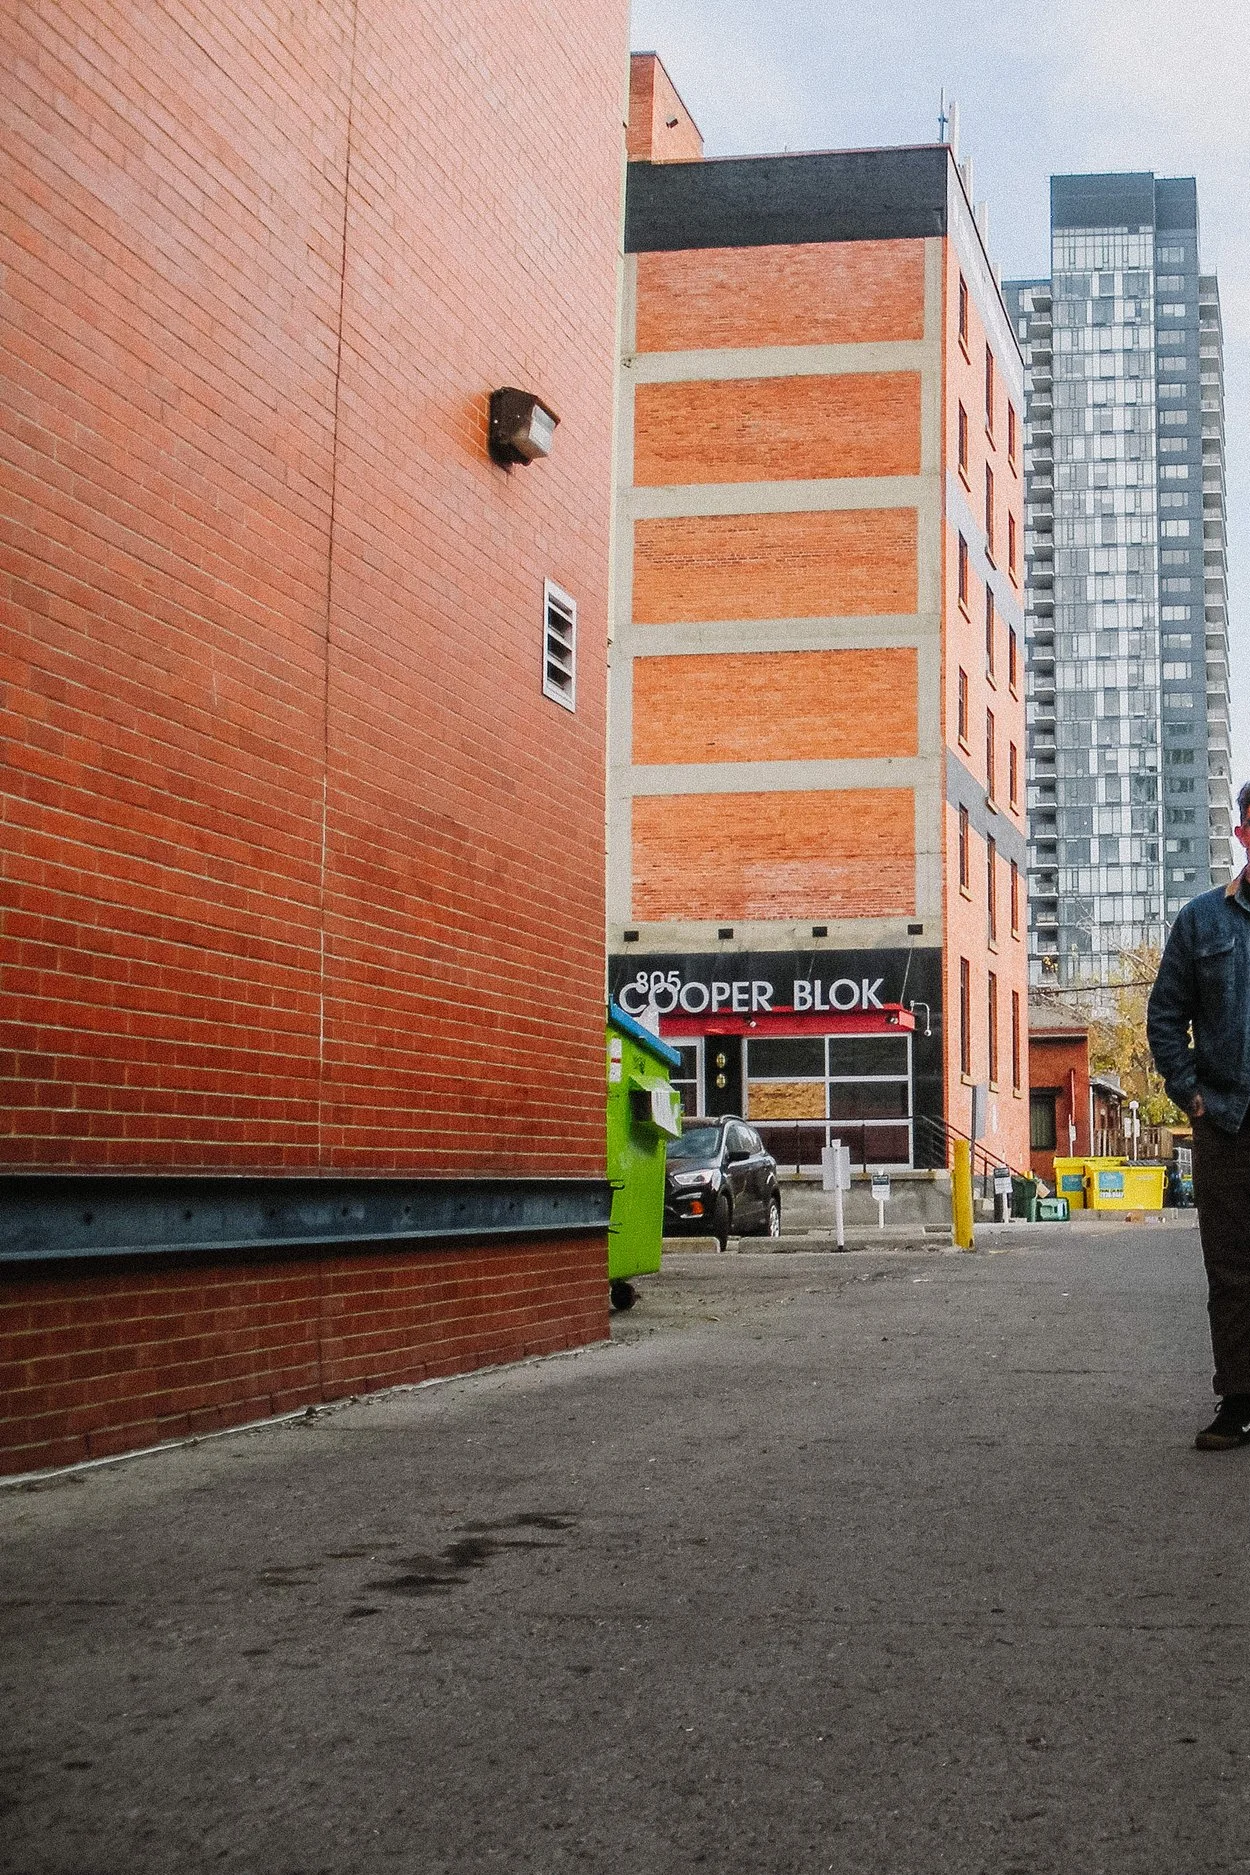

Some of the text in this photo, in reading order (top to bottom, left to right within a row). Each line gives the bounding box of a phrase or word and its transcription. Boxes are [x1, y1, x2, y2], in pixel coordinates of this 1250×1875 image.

[619, 978, 885, 1013] COOPER BLOK
[636, 971, 681, 993] 805
